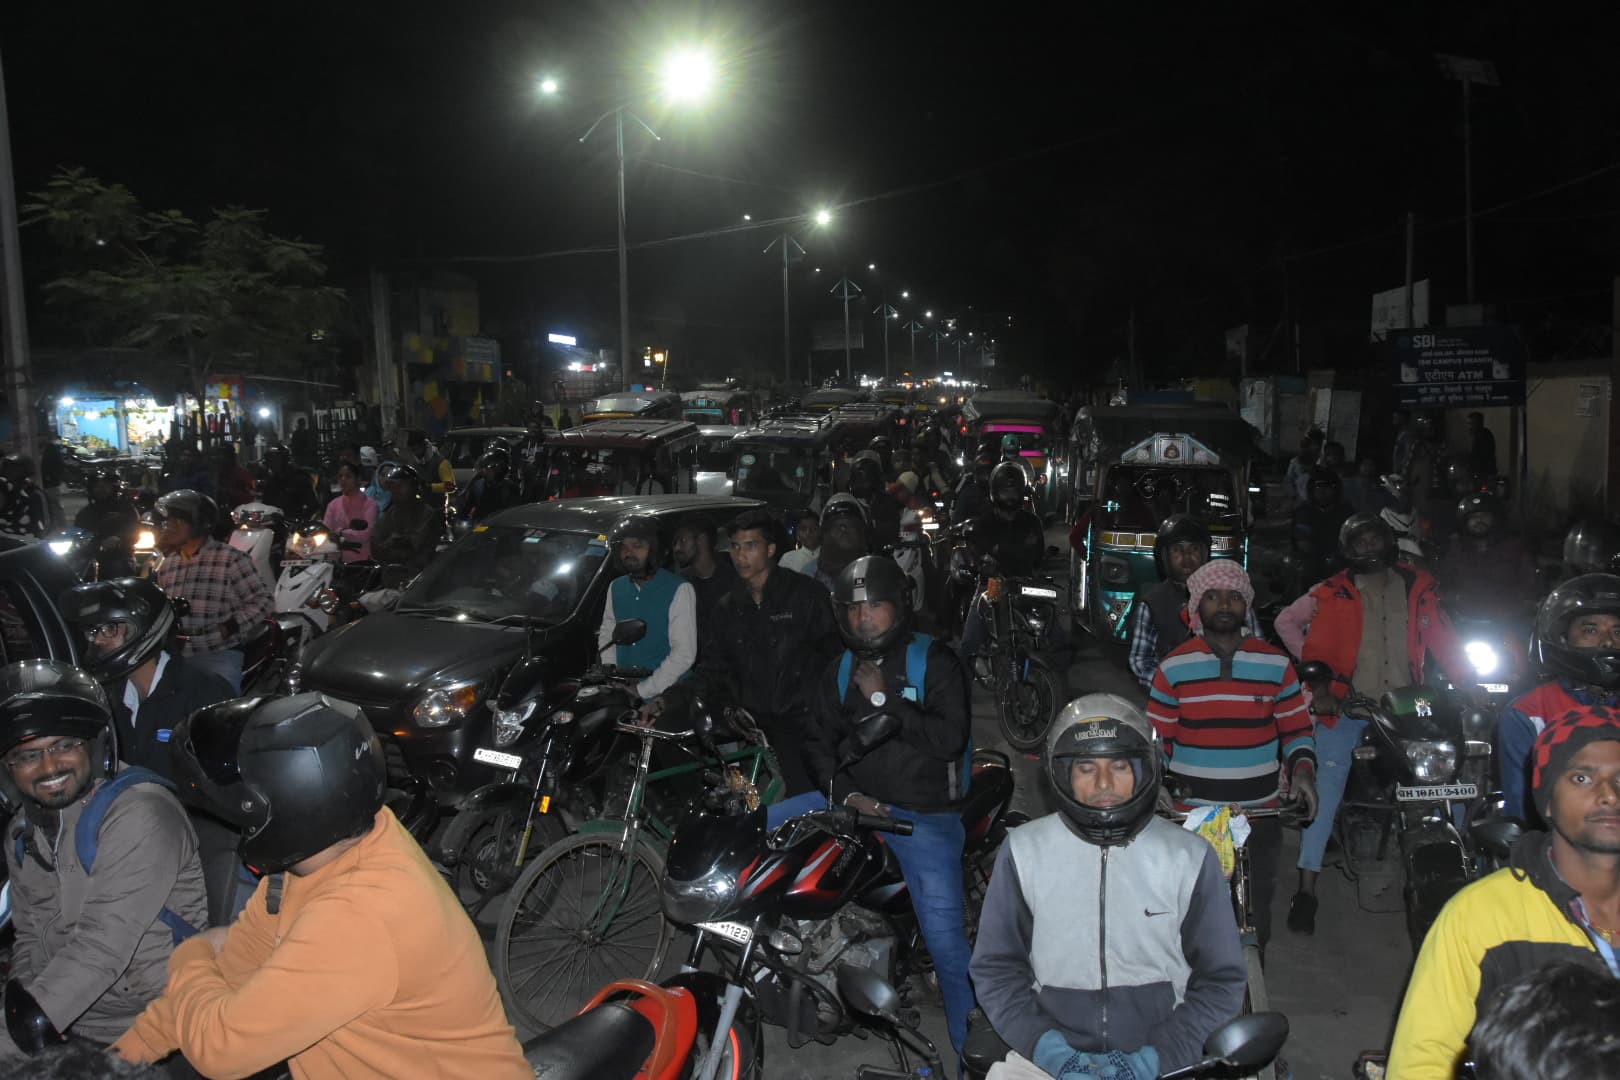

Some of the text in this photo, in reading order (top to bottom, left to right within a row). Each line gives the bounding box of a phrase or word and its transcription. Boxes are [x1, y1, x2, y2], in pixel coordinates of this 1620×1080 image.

[1412, 334, 1436, 348] SBI
[1433, 357, 1462, 366] CAMPUS
[1458, 370, 1484, 379] ATM
